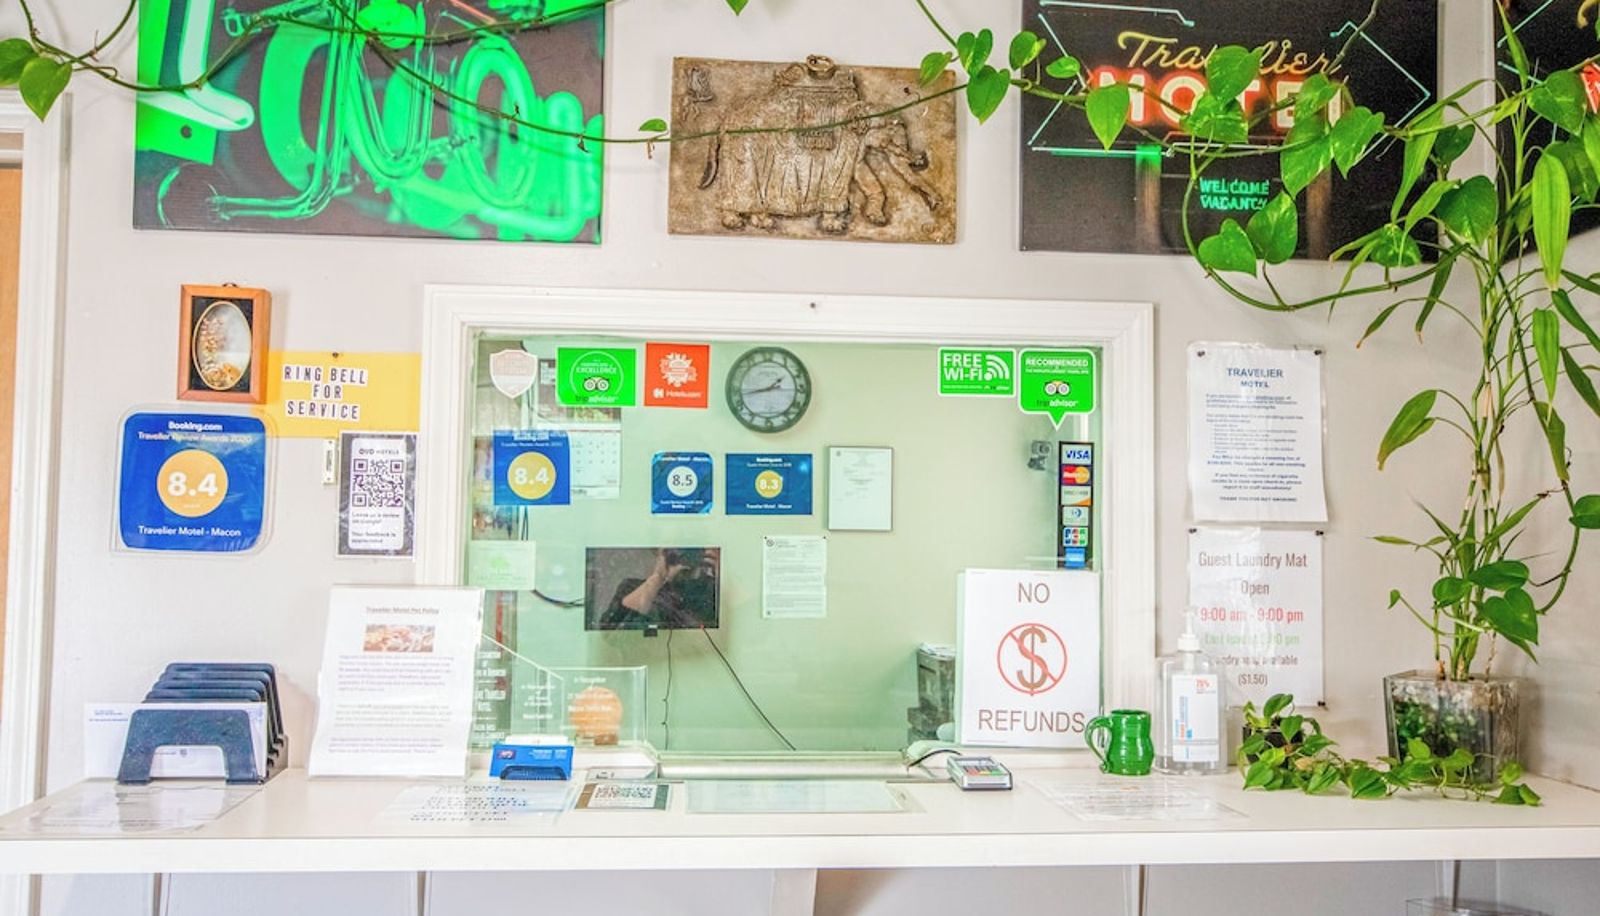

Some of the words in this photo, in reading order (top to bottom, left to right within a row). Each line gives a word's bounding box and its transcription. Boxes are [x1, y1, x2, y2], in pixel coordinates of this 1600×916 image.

[1118, 31, 1341, 74] Tralier
[1200, 178, 1269, 194] WELCOME
[943, 353, 982, 368] FREE
[1025, 358, 1088, 367] RECOMMENDED
[284, 366, 322, 381] RING
[330, 368, 365, 384] BELL
[943, 368, 982, 381] WI-FI
[1227, 367, 1283, 378] TRAVELIER
[313, 385, 341, 398] FOR
[287, 401, 358, 419] SERVICE
[168, 421, 223, 432] Booking.com
[1065, 450, 1090, 459] VISA
[167, 471, 218, 497] 8.4
[514, 467, 549, 485] 8.4
[672, 474, 693, 487] 8.5
[759, 479, 779, 490] 8.3
[138, 525, 176, 535] Travelier
[178, 526, 204, 535] Motel
[211, 527, 241, 536] Macon
[1199, 552, 1231, 566] Guest
[1236, 552, 1282, 569] Laundry
[1286, 553, 1307, 567] Mat
[1018, 582, 1050, 604] NO
[1241, 580, 1269, 596] Open
[1201, 608, 1226, 621] 9:00
[1230, 610, 1246, 621] am
[1257, 608, 1283, 622] 9:00
[1287, 611, 1304, 624] pm
[978, 709, 1086, 733] REFUNDS
